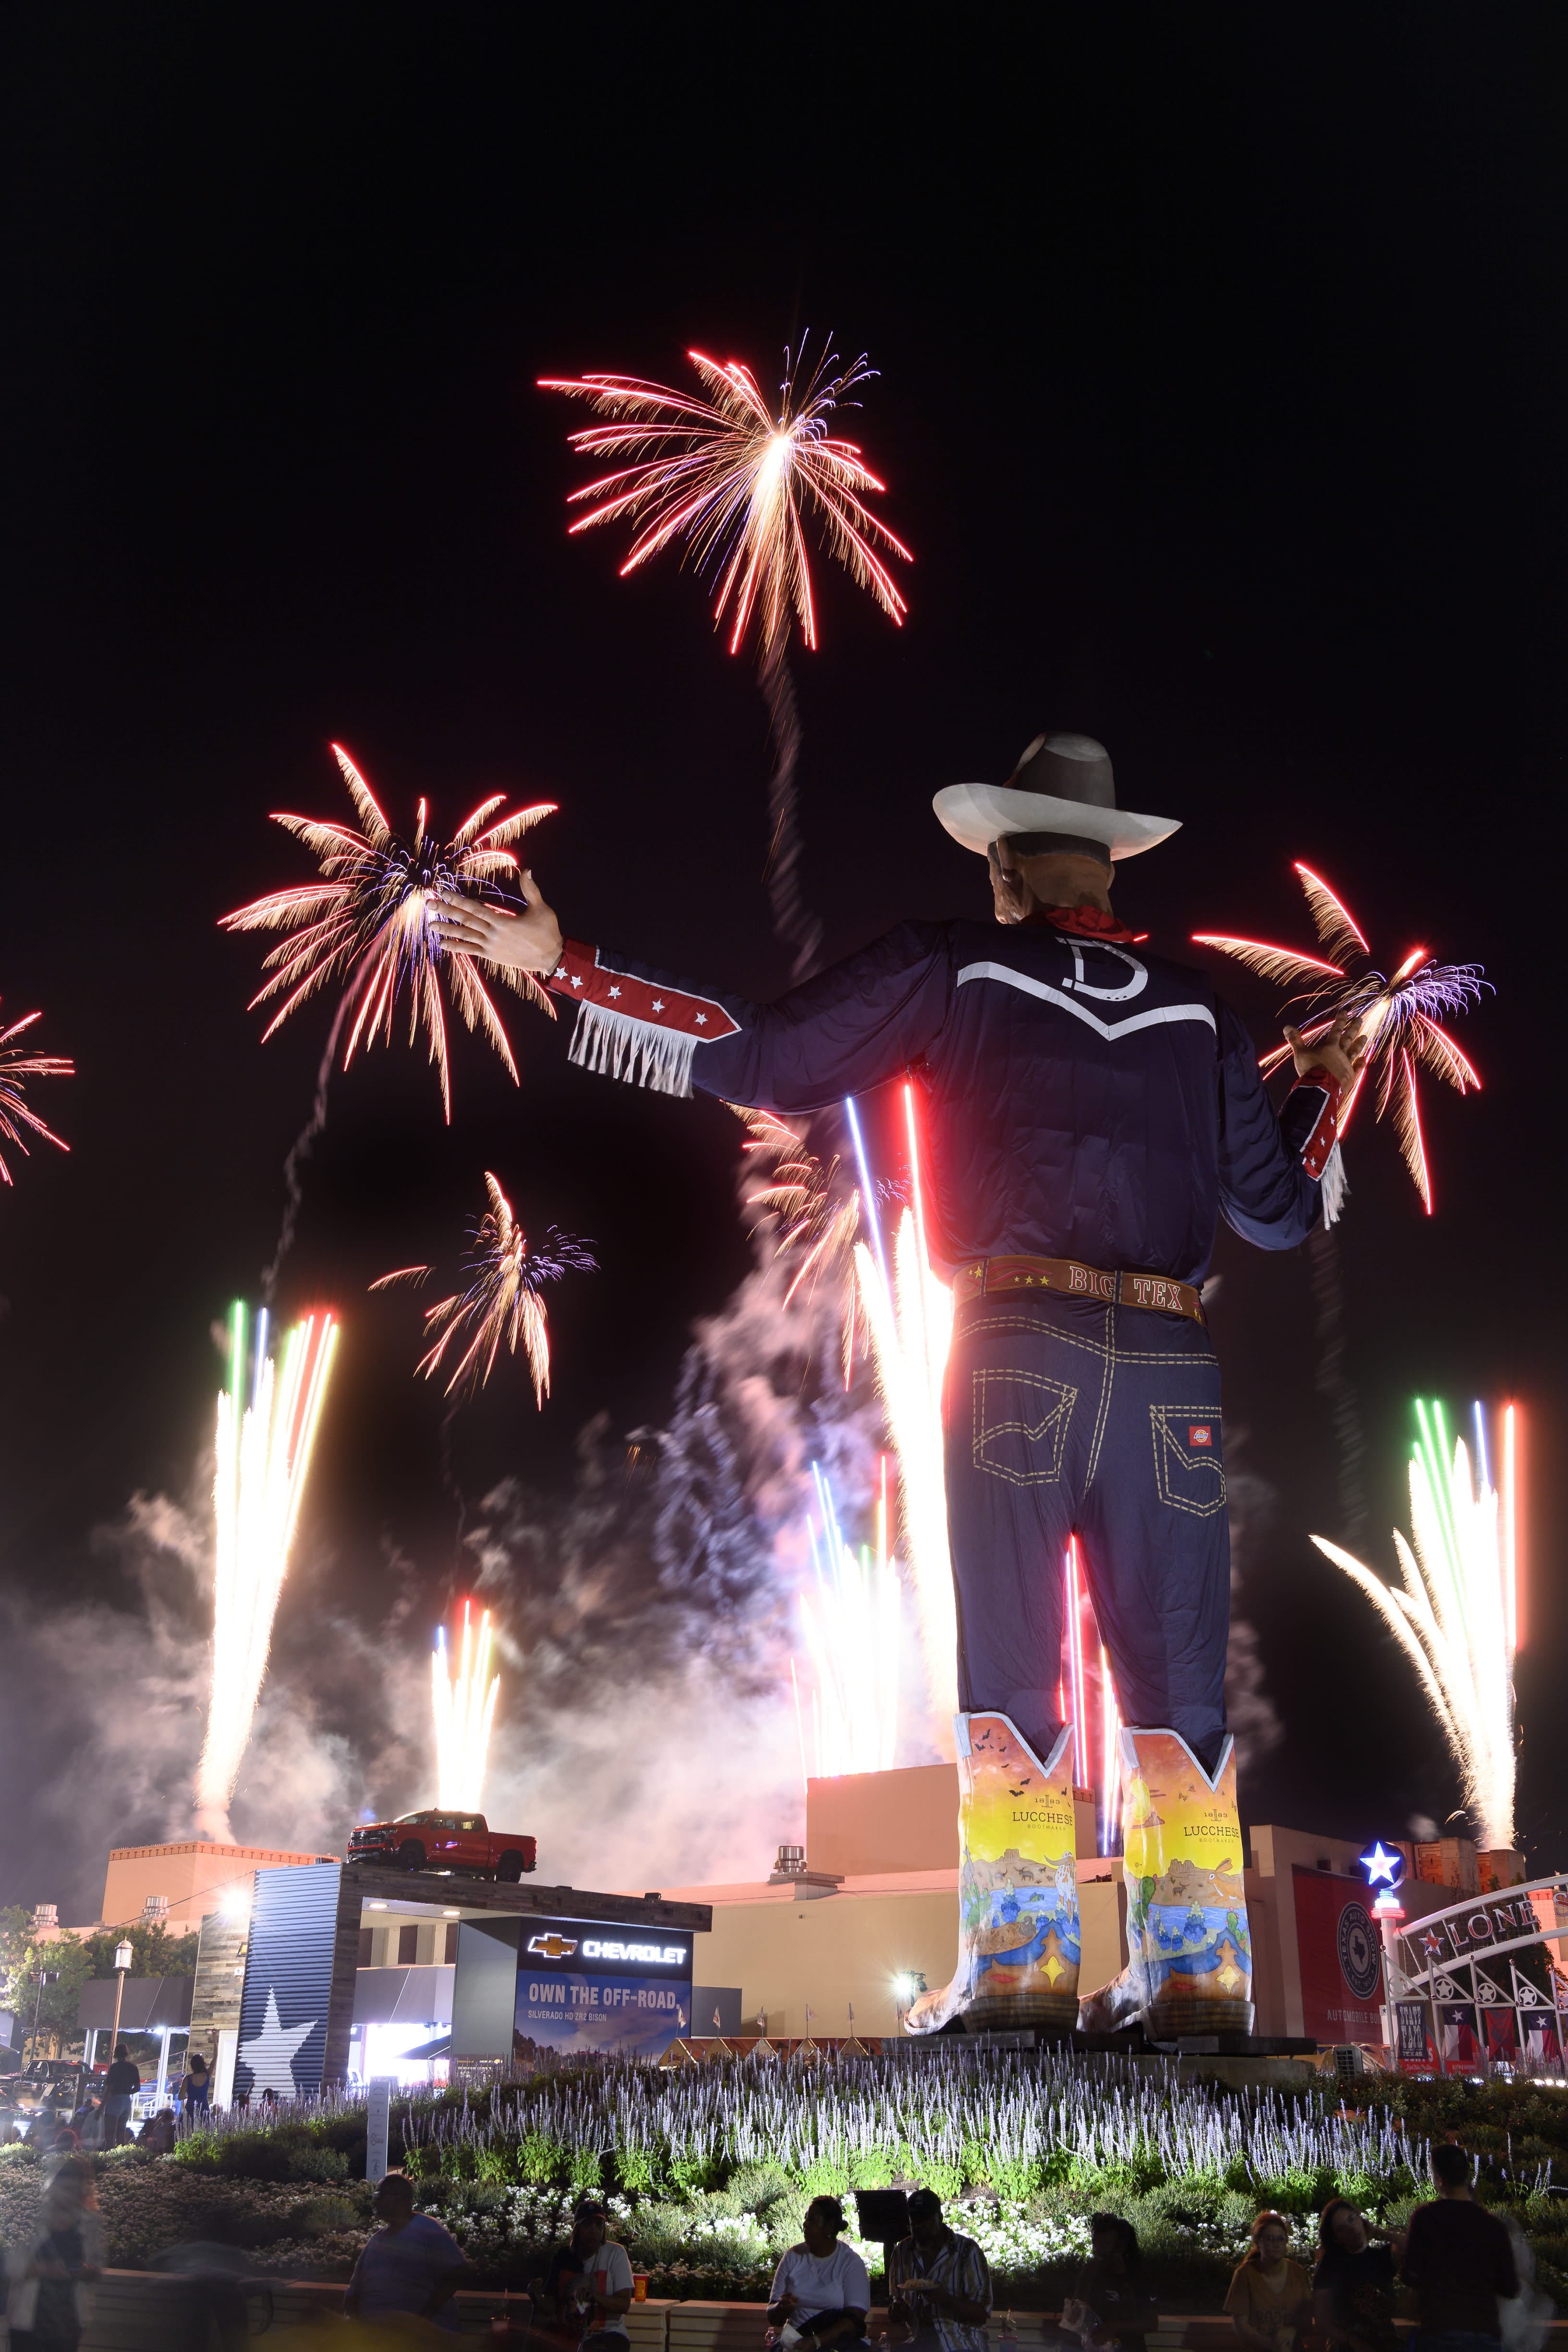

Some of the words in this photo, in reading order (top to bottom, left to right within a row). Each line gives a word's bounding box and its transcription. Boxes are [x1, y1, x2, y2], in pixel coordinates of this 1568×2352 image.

[1069, 1266, 1115, 1298] BIG
[1134, 1278, 1182, 1310] TEX
[1012, 1811, 1073, 1826] LUCCHESE
[1183, 1826, 1240, 1838] LUCCHESE
[1447, 1899, 1538, 1947] LONE
[1341, 1919, 1349, 1962] TEXAS
[1349, 1911, 1365, 1924] AUTO
[1366, 1925, 1376, 1965] SHOW
[583, 1940, 686, 1964] CHEVROLET
[529, 1983, 565, 2003] OWN
[570, 1986, 599, 2006] THE
[603, 1988, 680, 2009] OFF-ROAD.
[528, 2010, 563, 2020] SILVERADO
[565, 2012, 573, 2021] HD
[575, 2013, 587, 2021] ZR2
[588, 2013, 607, 2022] BISON
[1327, 2009, 1368, 2023] AUTOMOBILE
[1399, 2006, 1421, 2025] STATE
[1401, 2025, 1422, 2049] FAIR
